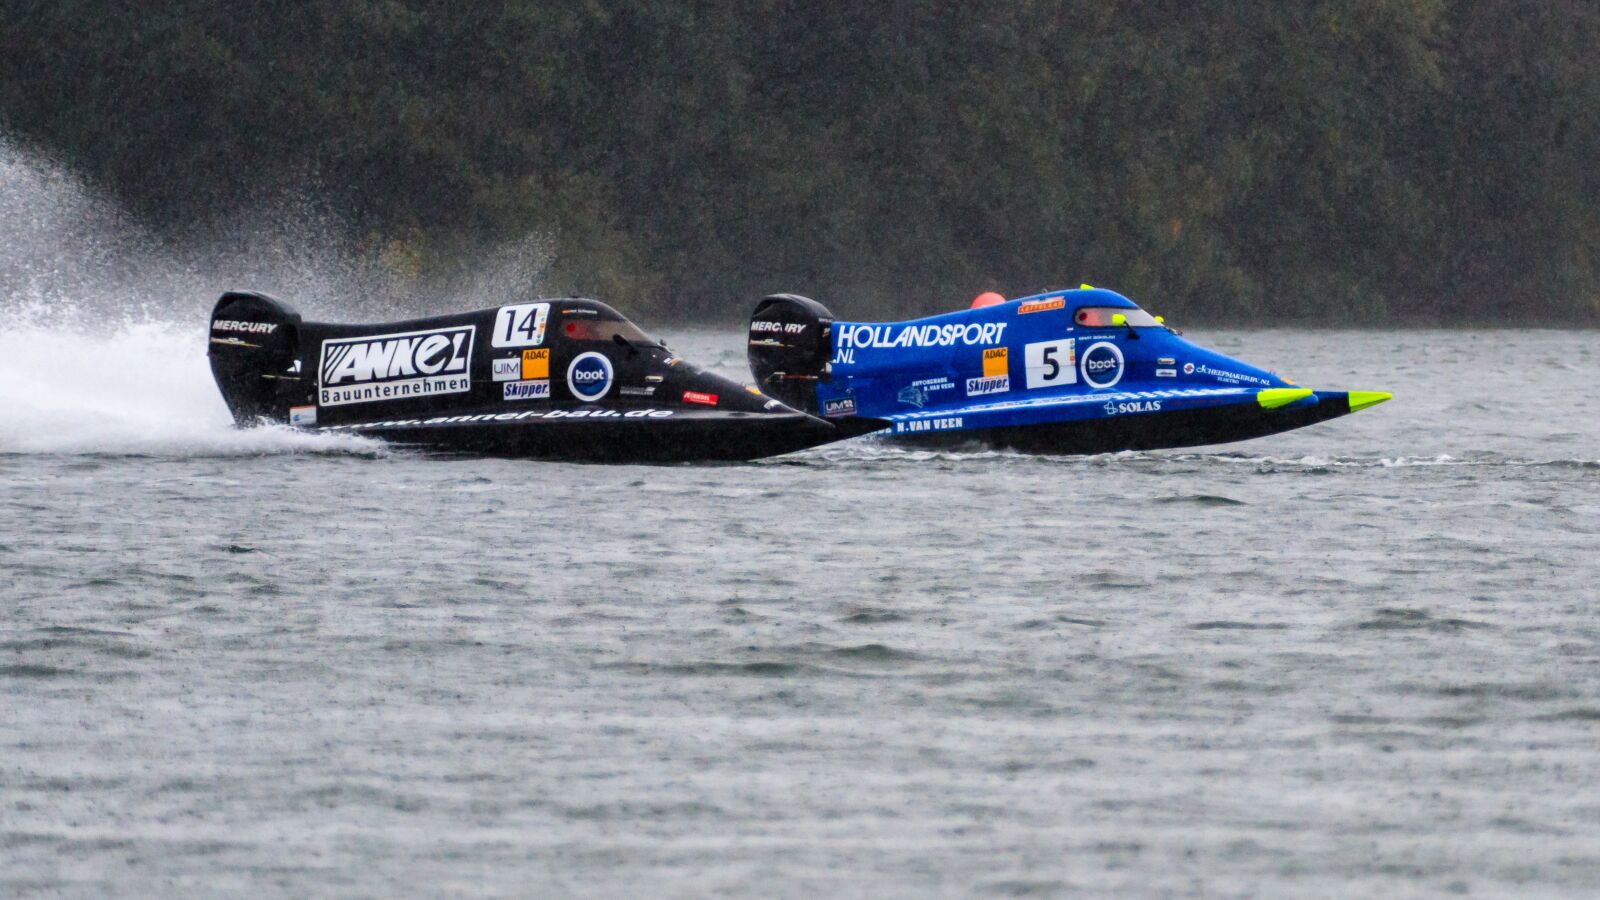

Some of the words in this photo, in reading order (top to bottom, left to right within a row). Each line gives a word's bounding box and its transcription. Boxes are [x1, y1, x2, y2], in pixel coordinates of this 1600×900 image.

[212, 320, 278, 334] MERCURY
[505, 308, 538, 342] 14
[837, 323, 1007, 348] HOLLANDSPORT
[524, 350, 548, 361] ADAC
[832, 348, 855, 364] .NL
[984, 349, 1007, 360] ADAC
[494, 362, 519, 375] UIM
[1043, 346, 1060, 381] 5
[1089, 358, 1117, 370] boot
[575, 369, 605, 380] boot
[321, 378, 468, 404] Bauunternehmen
[1119, 401, 1161, 413] SOLAS
[933, 417, 963, 429] VEEN
